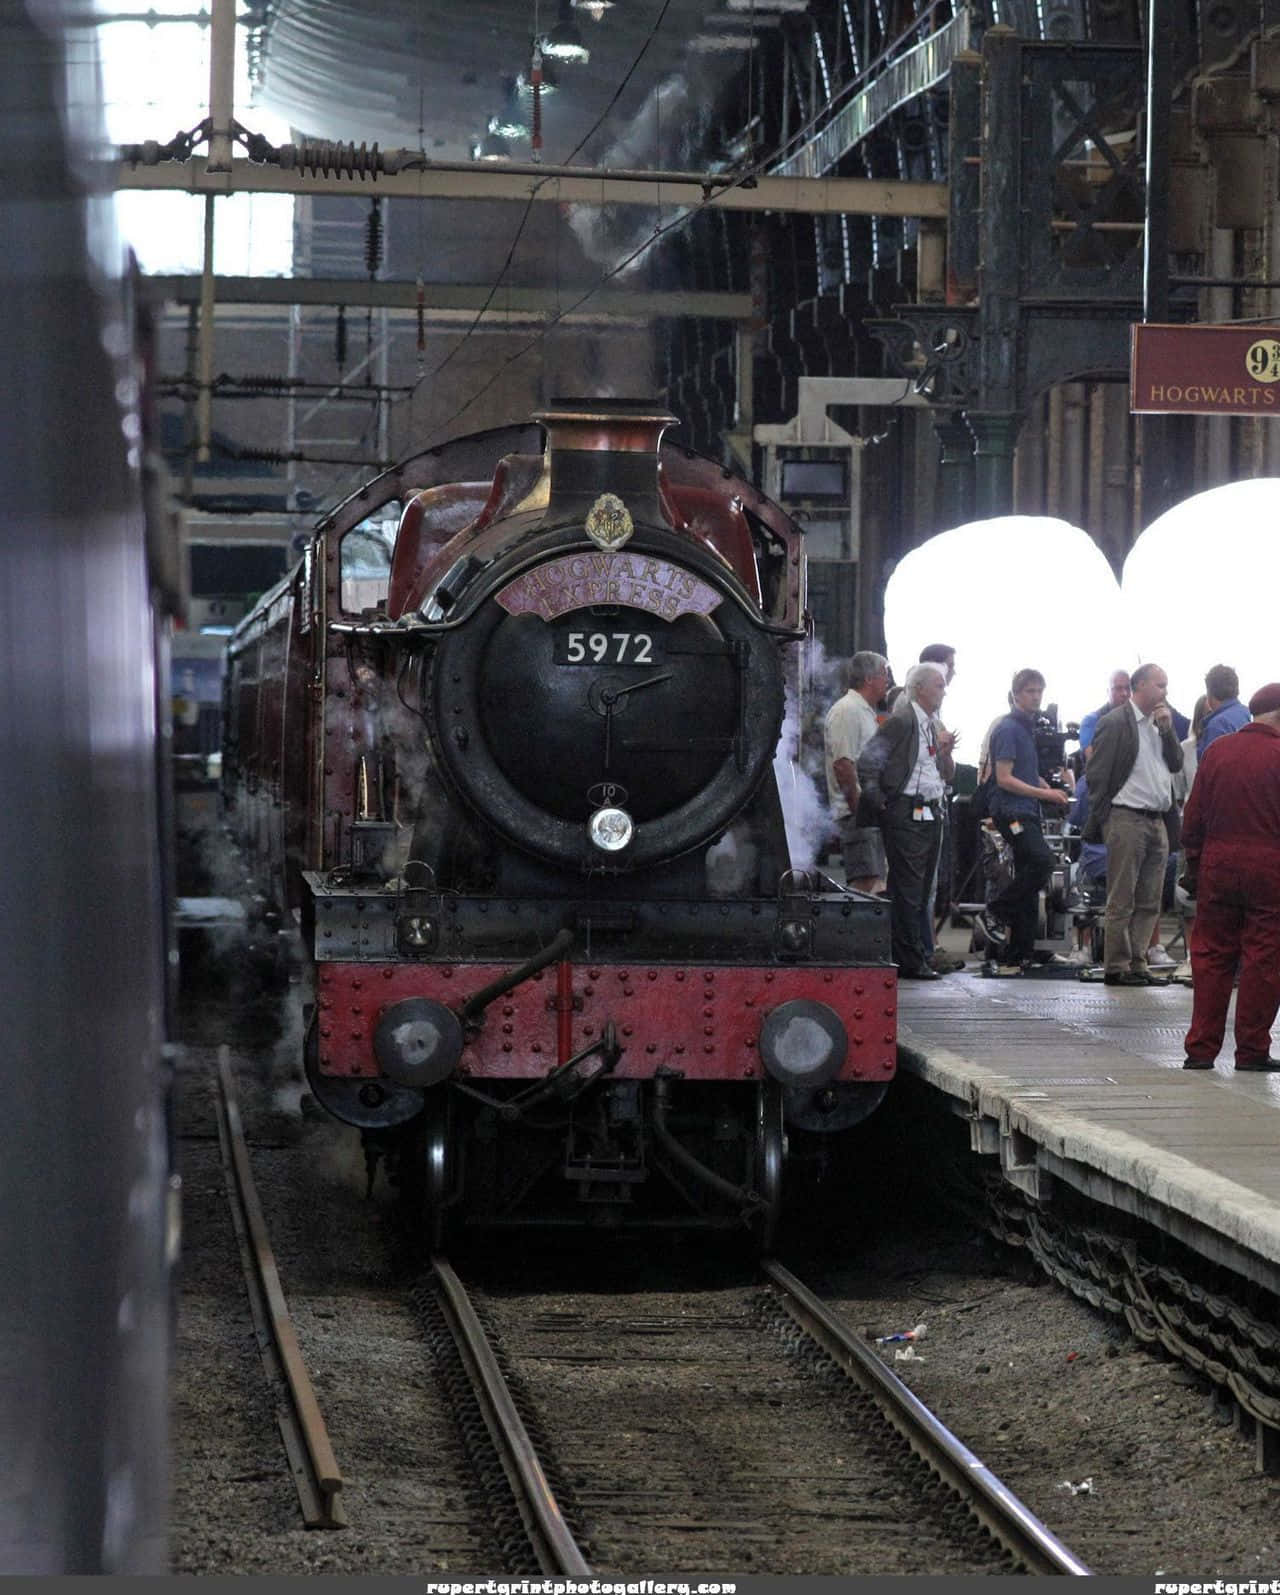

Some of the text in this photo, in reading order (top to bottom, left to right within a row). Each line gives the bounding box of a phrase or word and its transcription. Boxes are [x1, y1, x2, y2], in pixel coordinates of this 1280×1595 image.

[1151, 385, 1275, 405] HOGWARTS
[525, 554, 697, 600] HOGWARTS
[540, 580, 680, 616] EXPRESS
[567, 632, 652, 663] 5972
[603, 785, 616, 797] 10
